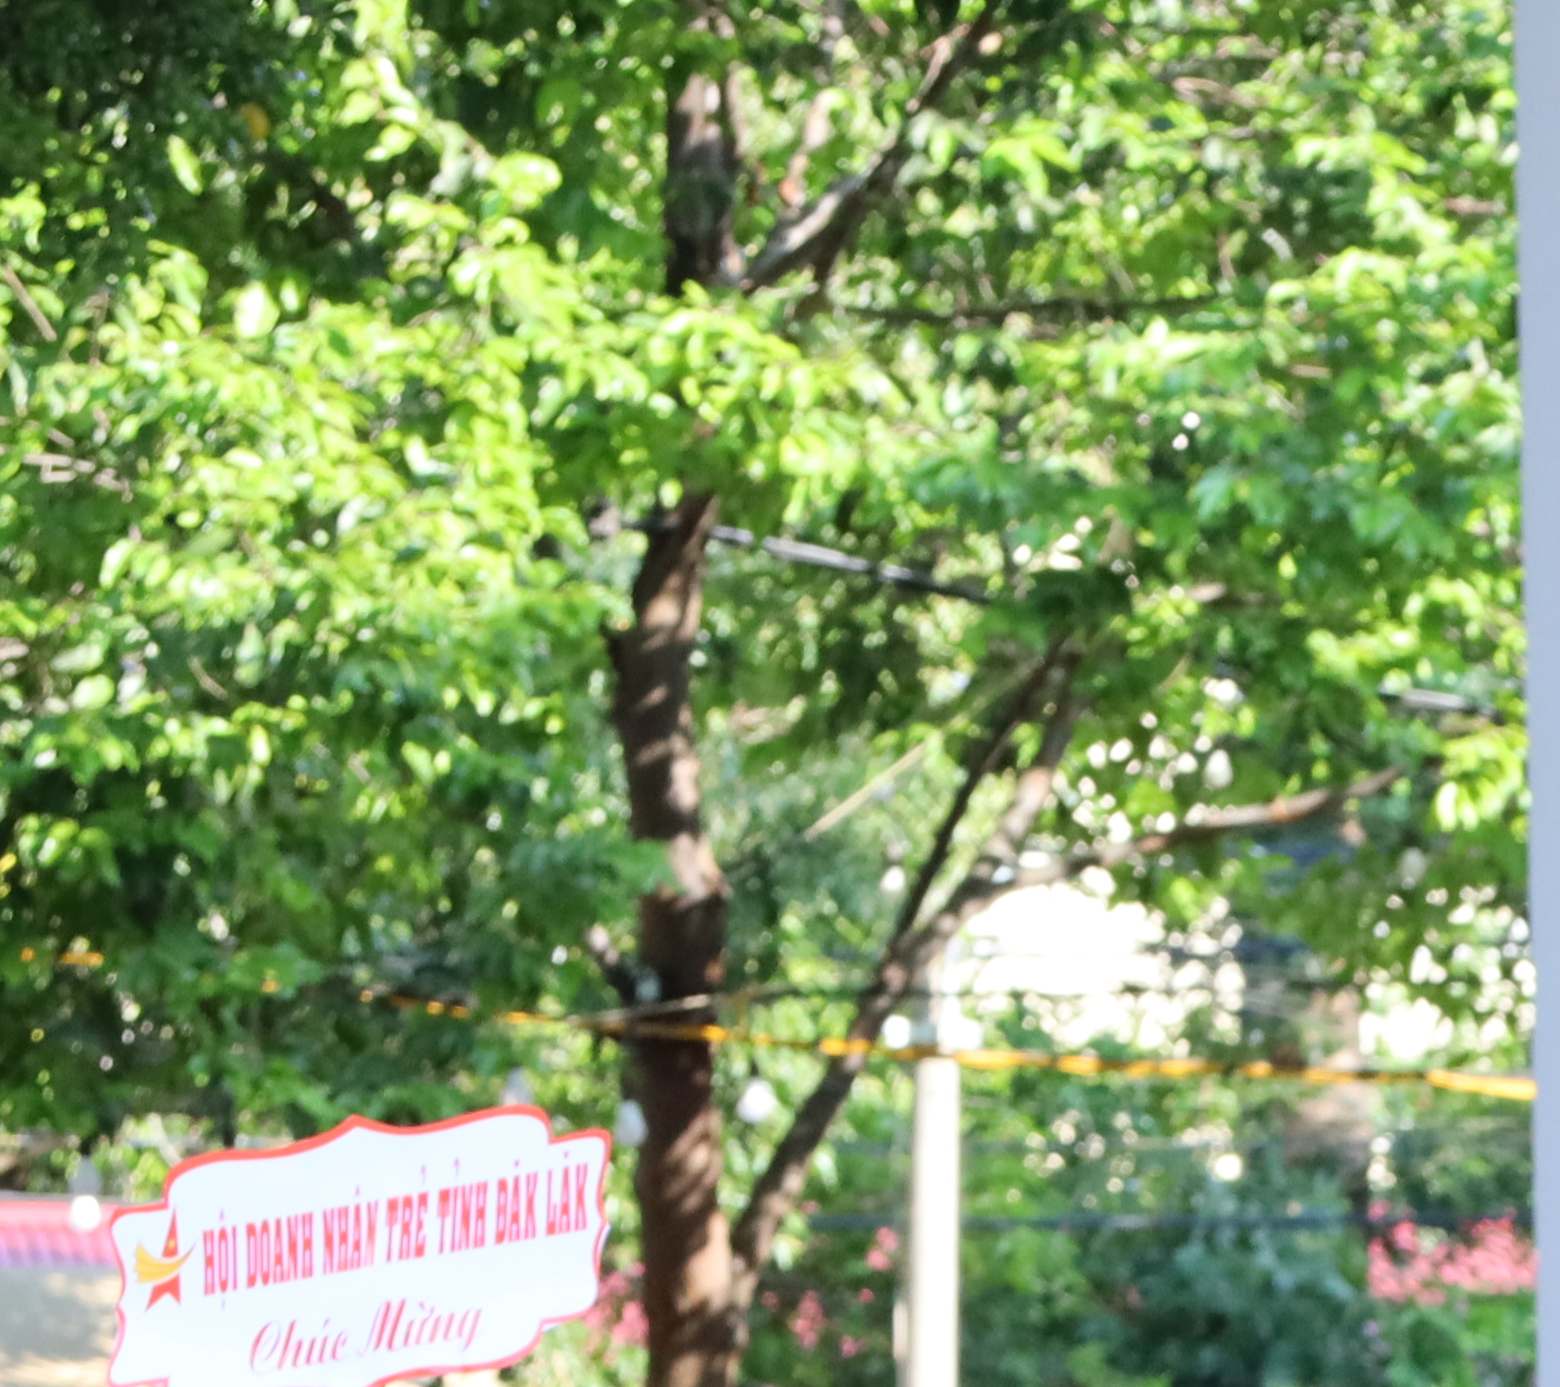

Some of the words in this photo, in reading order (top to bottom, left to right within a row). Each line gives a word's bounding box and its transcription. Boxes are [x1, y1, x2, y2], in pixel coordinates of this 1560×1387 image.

[202, 1207, 239, 1311] HỘI
[245, 1211, 314, 1290] DOANH
[322, 1184, 380, 1276] NHÂN
[385, 1164, 429, 1264] TRẺ
[437, 1156, 489, 1255] TỈNH
[249, 1316, 350, 1377] Chúc
[355, 1297, 485, 1359] Mừng
